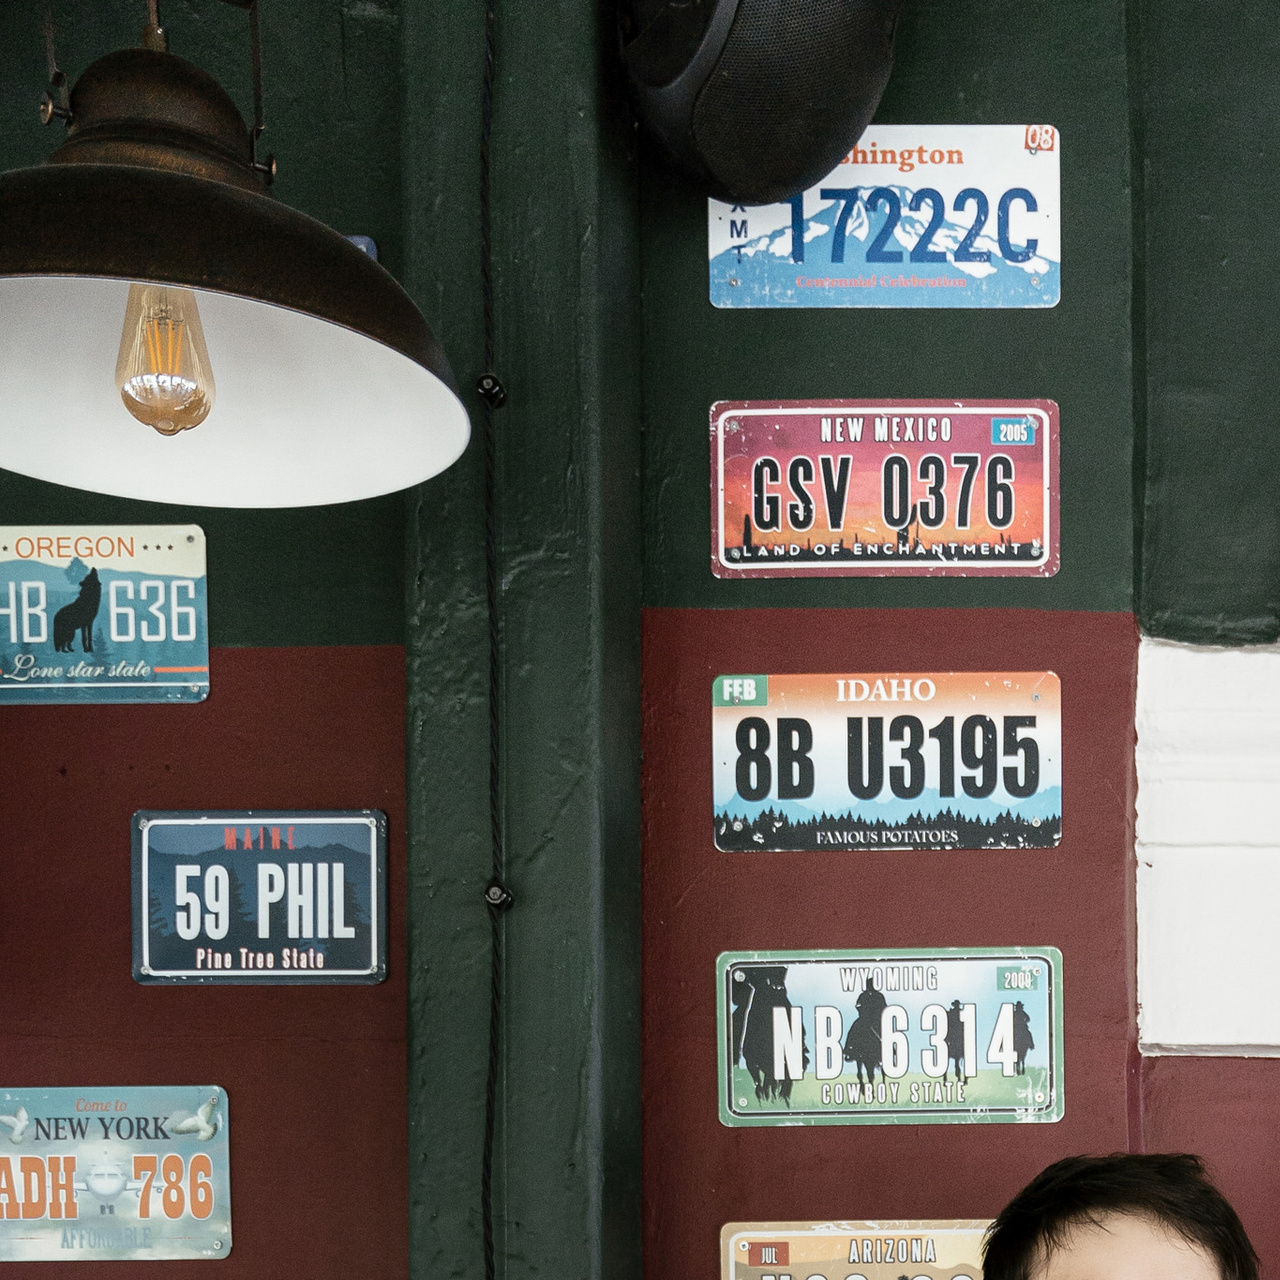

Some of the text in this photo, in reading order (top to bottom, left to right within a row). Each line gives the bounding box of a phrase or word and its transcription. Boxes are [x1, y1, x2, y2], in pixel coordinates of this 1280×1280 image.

[1026, 125, 1055, 150] 08
[786, 187, 1039, 264] 17222C
[796, 275, 967, 289] Centennial Celebration
[821, 417, 953, 443] NEW MEXICO
[1000, 423, 1028, 443] 2005
[751, 453, 1015, 533] GSV 0376
[15, 536, 135, 559] OREGON
[743, 543, 1022, 558] LAND OF ENCHANTMENT
[109, 579, 197, 643] 636
[3, 653, 152, 682] Lone star state
[836, 678, 937, 703] IDAHO
[734, 714, 1041, 802] 8B U3195
[223, 826, 296, 851] MAINE
[816, 829, 959, 845] FAMOUS POTATOES
[175, 862, 356, 941] 59 PHIL
[195, 948, 325, 969] Pine Tree State
[839, 966, 939, 992] WYOMING
[772, 1002, 1019, 1082] NB 6314
[75, 1097, 128, 1112] Come to
[820, 1080, 966, 1105] COWBOY STATE
[34, 1116, 171, 1141] NEW YORK
[132, 1154, 214, 1219] 786
[60, 1226, 152, 1249] AFFORDABLE
[760, 1247, 779, 1265] JUL
[848, 1238, 937, 1264] ARIZONA
